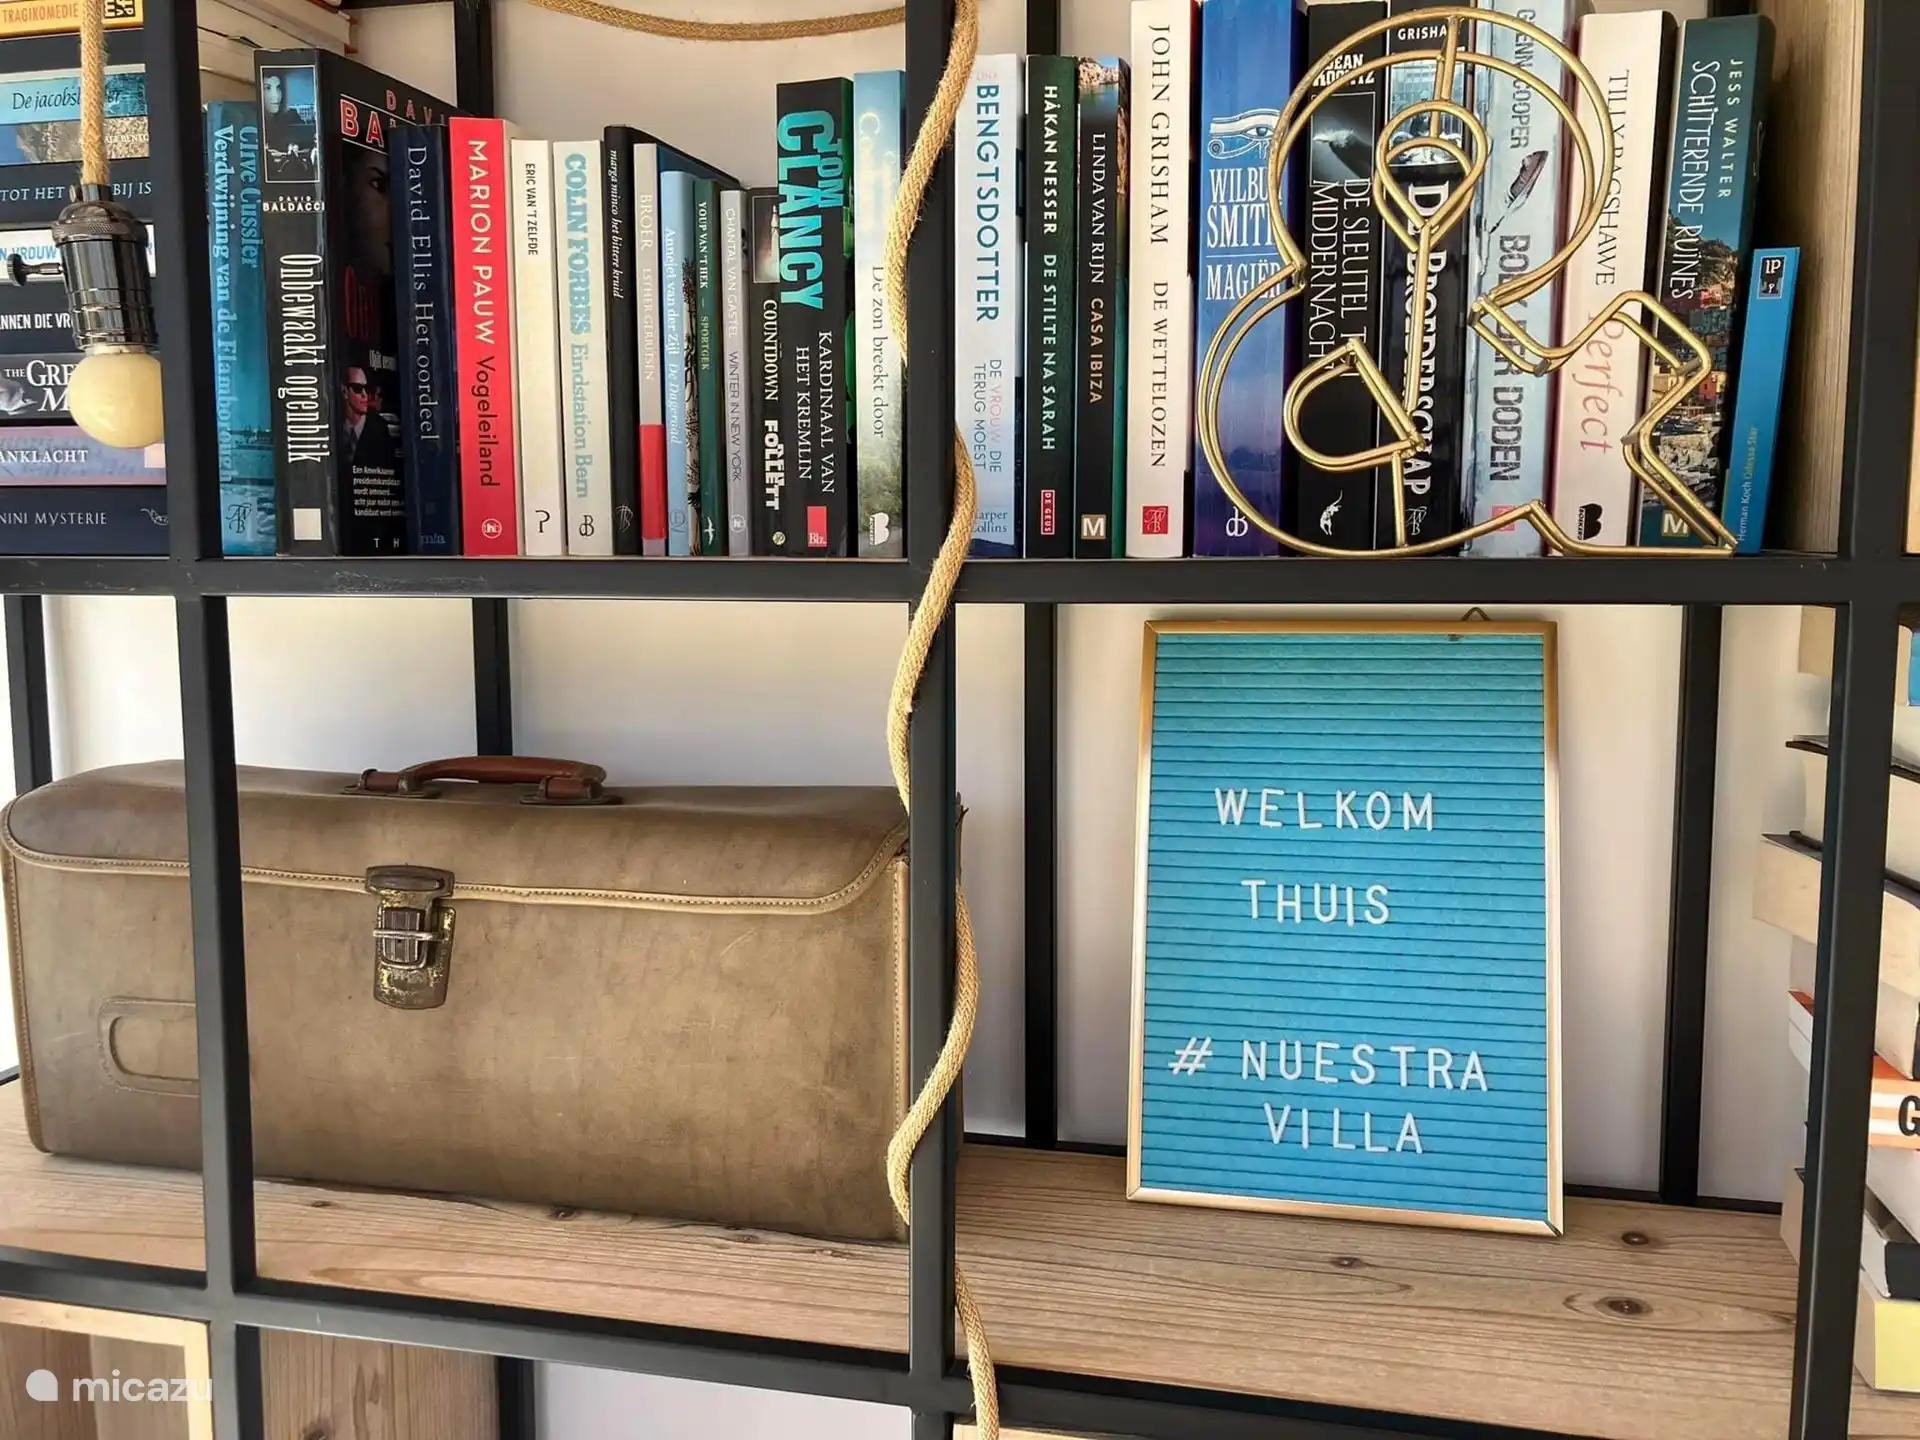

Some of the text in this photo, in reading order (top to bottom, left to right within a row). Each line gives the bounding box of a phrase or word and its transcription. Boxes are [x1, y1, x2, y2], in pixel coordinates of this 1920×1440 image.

[1397, 24, 1455, 40] GRISHA
[1513, 8, 1538, 68] GENN
[13, 92, 31, 110] De
[1716, 58, 1745, 199] JESS WALTER
[0, 187, 30, 201] TOT
[35, 186, 65, 200] HET
[138, 181, 152, 195] IS
[212, 125, 236, 258] Verdwijning
[239, 125, 264, 269] Clive Cussler
[262, 201, 326, 213] BALDACCI
[525, 162, 536, 186] ERIC
[526, 185, 537, 208] VAN
[778, 110, 834, 311] CLANCY
[817, 137, 845, 208] TOM
[975, 84, 1000, 322] BENGTSDOTTER
[1209, 166, 1283, 204] WILBU
[1343, 178, 1372, 212] DE
[1668, 60, 1722, 300] SCHITTERENDE RUÏNES
[527, 218, 540, 256] ZELFDE
[608, 150, 624, 299] marga minco het bittere kruid
[698, 201, 708, 231] YOUP
[699, 232, 708, 253] VAN
[1148, 24, 1171, 468] JOHN GRISHAM DE WETTELOZEN
[215, 263, 230, 301] van
[407, 147, 440, 441] David Ellis Het oordeel
[639, 194, 655, 381] BROER ESTHER GERRITSEN
[700, 266, 709, 288] HEK
[1041, 85, 1061, 451] HÅKAN NESSER DE STILTE NA SARAH
[1089, 132, 1107, 404] LINDA VAN RIJN CASA IBIZA
[1308, 179, 1339, 371] MIDDERNACH
[1341, 216, 1371, 320] SLEUTEL
[0, 314, 31, 330] NNEN
[34, 313, 53, 329] DIE
[216, 307, 238, 333] de
[468, 140, 501, 488] MARION PAUW Vogeleiland
[564, 153, 594, 499] COLIN FORBES Eindstation Bern
[664, 227, 682, 445] Annejet van der Zijl De Dageraad
[700, 315, 710, 371] SPORTGEK
[725, 208, 742, 482] CHANTAL VAN GASTEL WINTER IN NEW YORK
[763, 299, 779, 401] COUNTDOWN
[872, 266, 889, 439] De zon breekt door
[5, 359, 79, 387] THE GRE
[277, 254, 331, 464] Onbewaakt ogenblik
[216, 339, 241, 483] Flamborough
[795, 347, 812, 480] HET KREMLIN
[819, 331, 836, 494] KARDINAAL VAN
[973, 363, 987, 470] TERUG MOEST
[988, 358, 1002, 473] DE VROUW DIE
[1489, 386, 1525, 482] DODEN
[764, 419, 780, 511] FOLLETT
[1740, 481, 1753, 505] Koch
[34, 511, 108, 528] MYSTERIE
[1044, 491, 1052, 533] DE GEUS
[1082, 518, 1106, 537] M
[1736, 505, 1750, 542] Herman
[1214, 787, 1434, 833] WELKOM
[1240, 879, 1391, 926] THUIS
[1241, 1039, 1489, 1092] NUESTRA
[1263, 1102, 1424, 1154] VILLA
